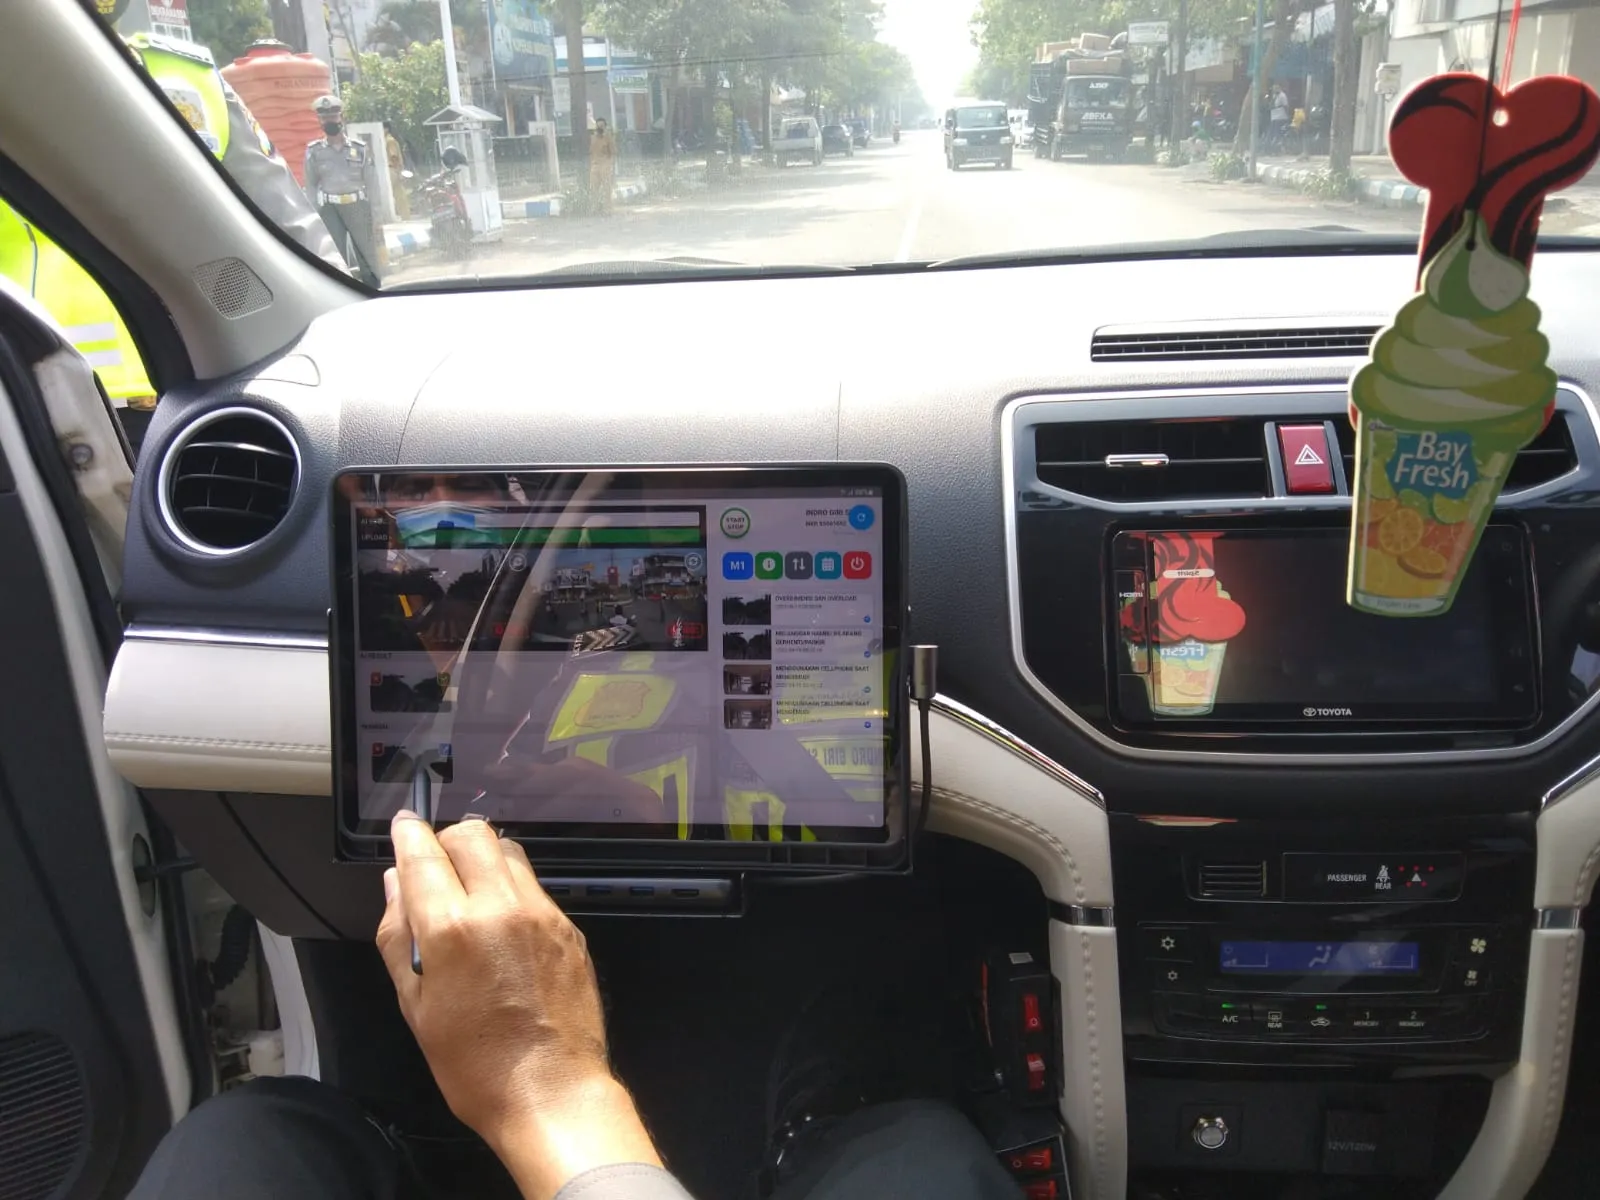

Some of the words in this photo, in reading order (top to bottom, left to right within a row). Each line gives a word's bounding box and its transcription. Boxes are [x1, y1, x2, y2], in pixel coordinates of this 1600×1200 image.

[1416, 431, 1468, 467] Bay
[1394, 453, 1470, 489] Fresh
[730, 560, 745, 570] M1
[1317, 708, 1352, 716] TOYOTA
[1375, 882, 1392, 890] REAR
